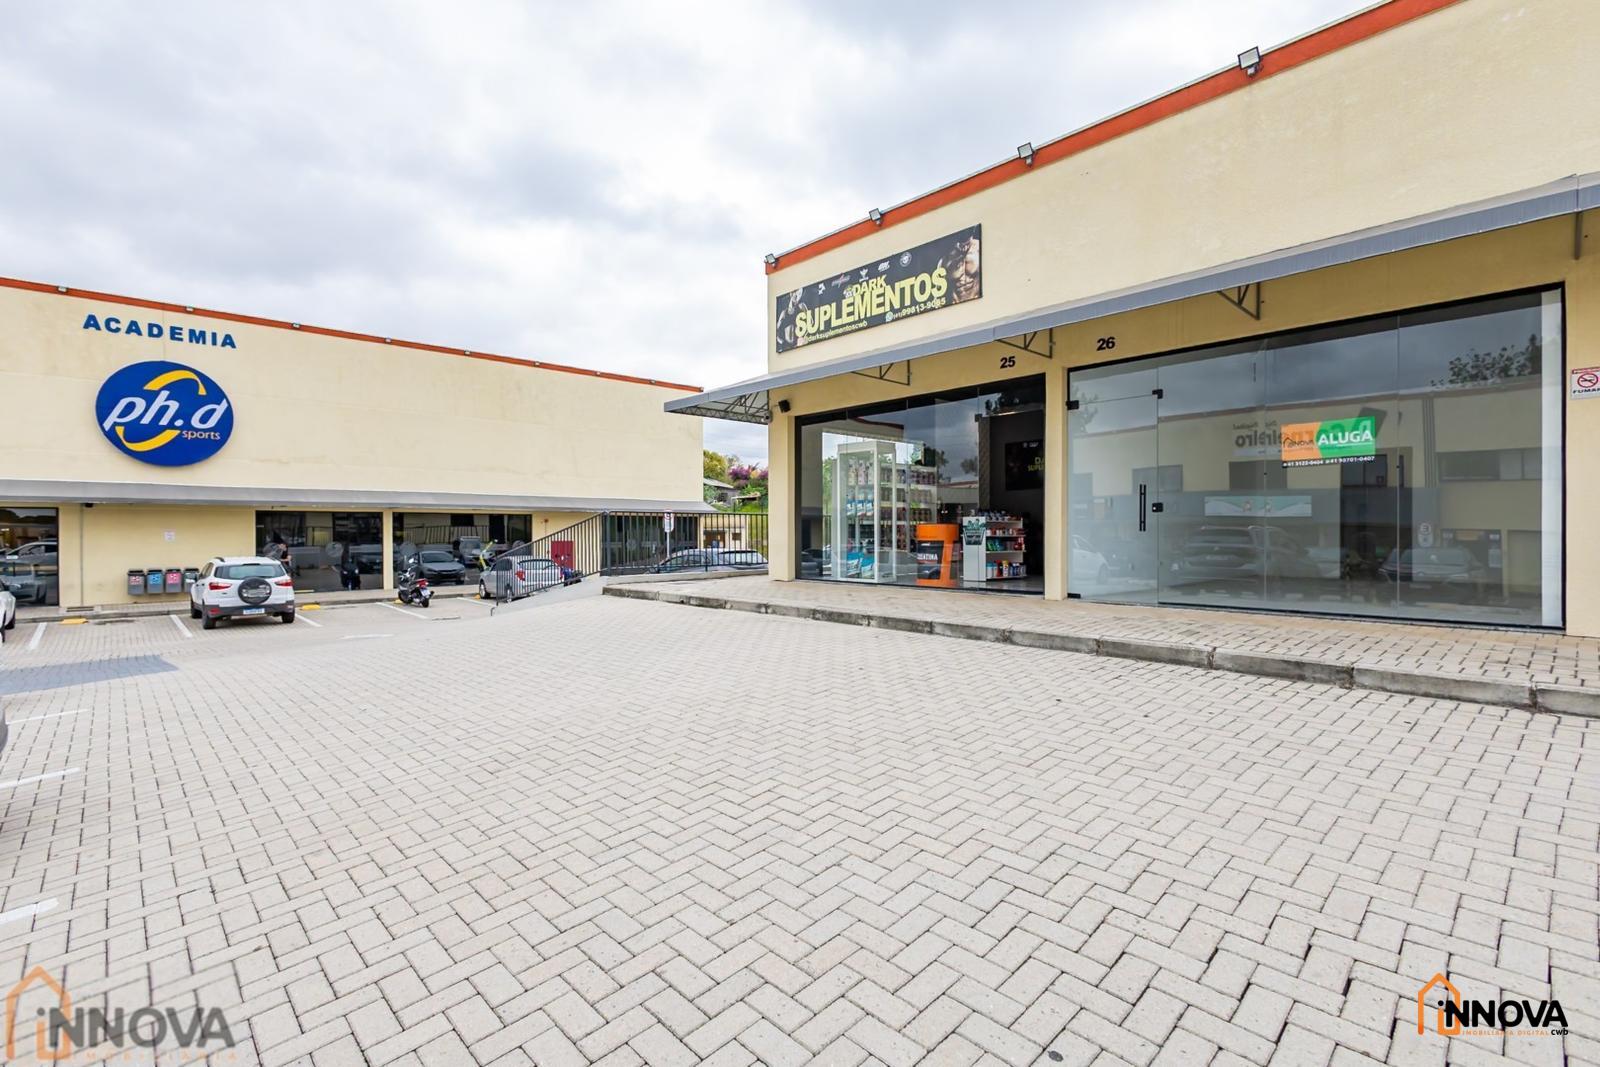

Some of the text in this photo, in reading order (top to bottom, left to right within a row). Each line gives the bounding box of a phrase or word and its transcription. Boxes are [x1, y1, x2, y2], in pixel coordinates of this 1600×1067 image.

[853, 274, 887, 297] DARK
[795, 267, 947, 338] SUPLEMENTOS
[83, 314, 236, 348] ACADEMIA
[1097, 337, 1115, 351] 26
[1000, 356, 1015, 369] 25
[103, 390, 228, 431] ph.d
[182, 430, 220, 440] sports
[1318, 430, 1373, 445] ALUGA
